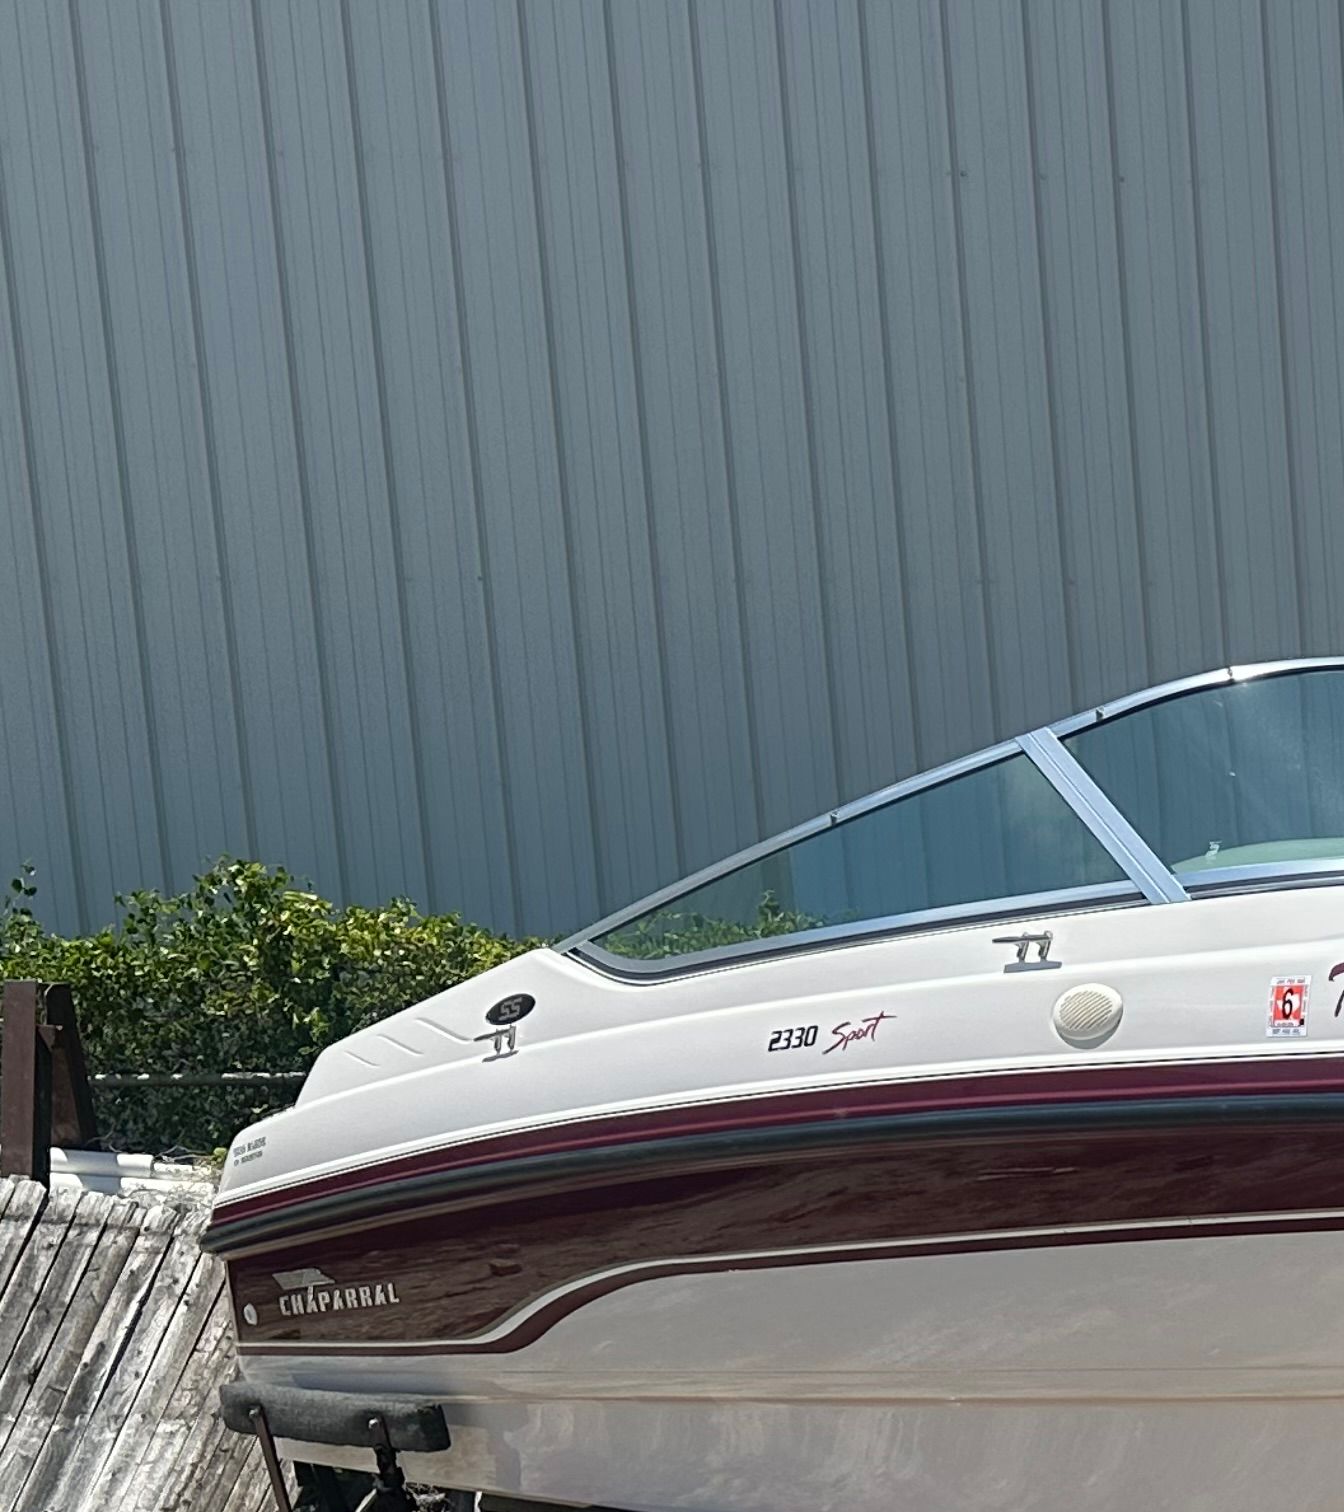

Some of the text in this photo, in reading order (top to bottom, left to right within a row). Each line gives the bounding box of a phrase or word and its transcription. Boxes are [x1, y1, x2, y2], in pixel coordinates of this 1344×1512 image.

[1281, 987, 1294, 1020] 6
[768, 1011, 897, 1055] 2330 Sport
[279, 1282, 400, 1316] CHAPARRAL
